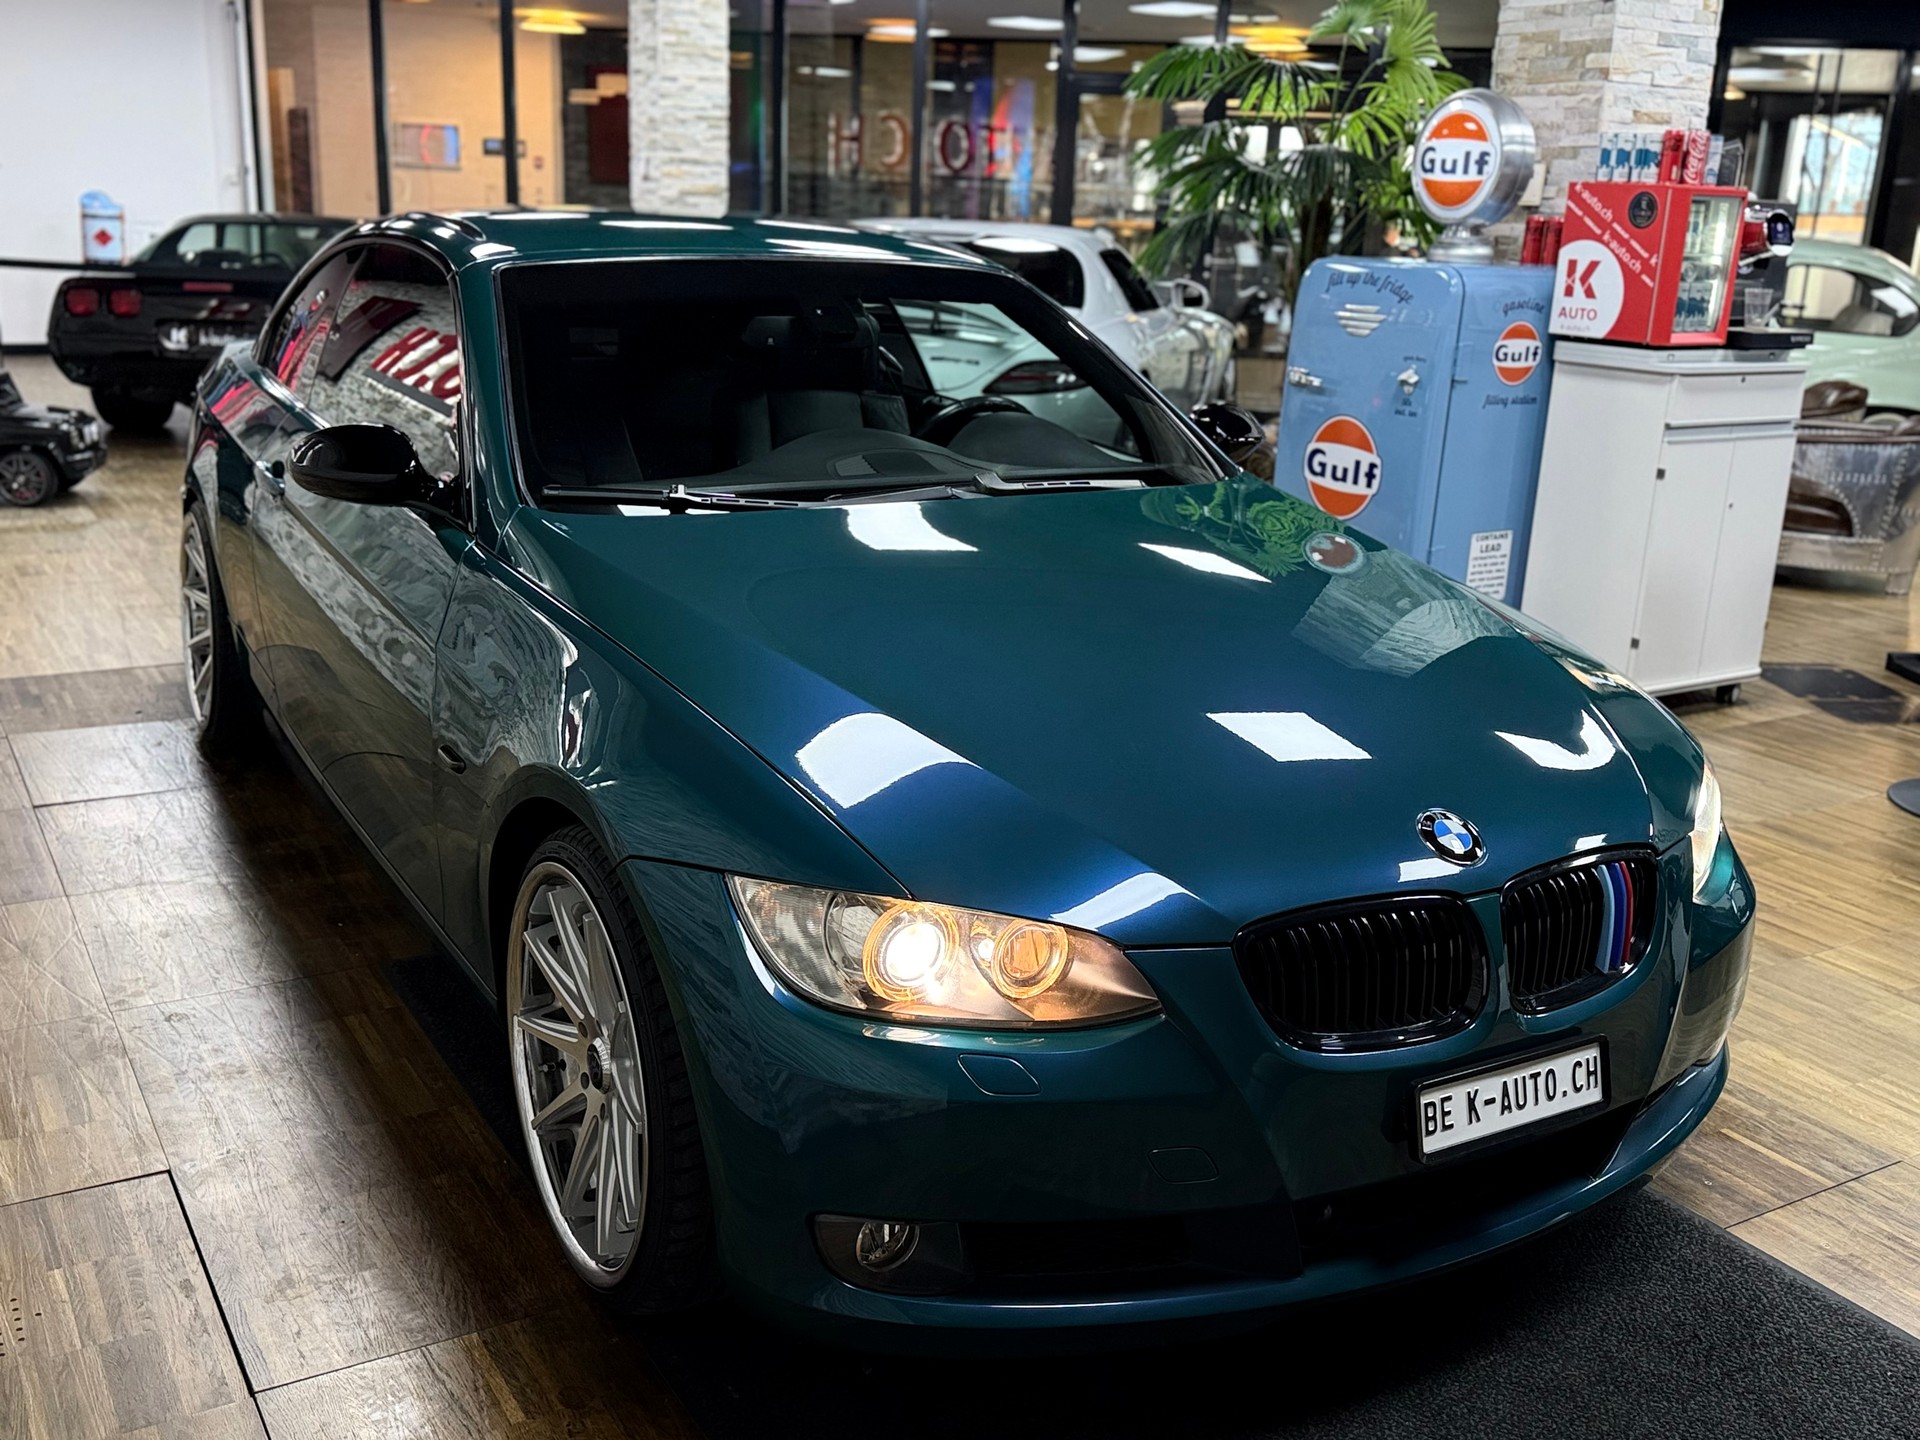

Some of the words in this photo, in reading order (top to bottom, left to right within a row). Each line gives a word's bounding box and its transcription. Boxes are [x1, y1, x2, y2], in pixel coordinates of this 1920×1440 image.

[1421, 146, 1491, 176] Gulf
[1574, 182, 1613, 222] k-auto.ch
[1602, 230, 1642, 273] k-auto.ch
[1325, 272, 1344, 293] fill
[1346, 273, 1361, 288] up
[1362, 271, 1381, 287] the
[1376, 274, 1414, 304] fridge
[1564, 259, 1602, 299] K
[1503, 297, 1545, 317] gasoline
[1558, 306, 1597, 320] AUTO
[1495, 344, 1540, 362] Gulf
[1482, 394, 1509, 409] filling
[1307, 447, 1378, 489] Gulf
[1476, 532, 1508, 542] CONTAINS
[1480, 543, 1501, 553] LEAD
[1424, 1095, 1454, 1137] BE
[1466, 1055, 1599, 1125] K-AUTO.CH
